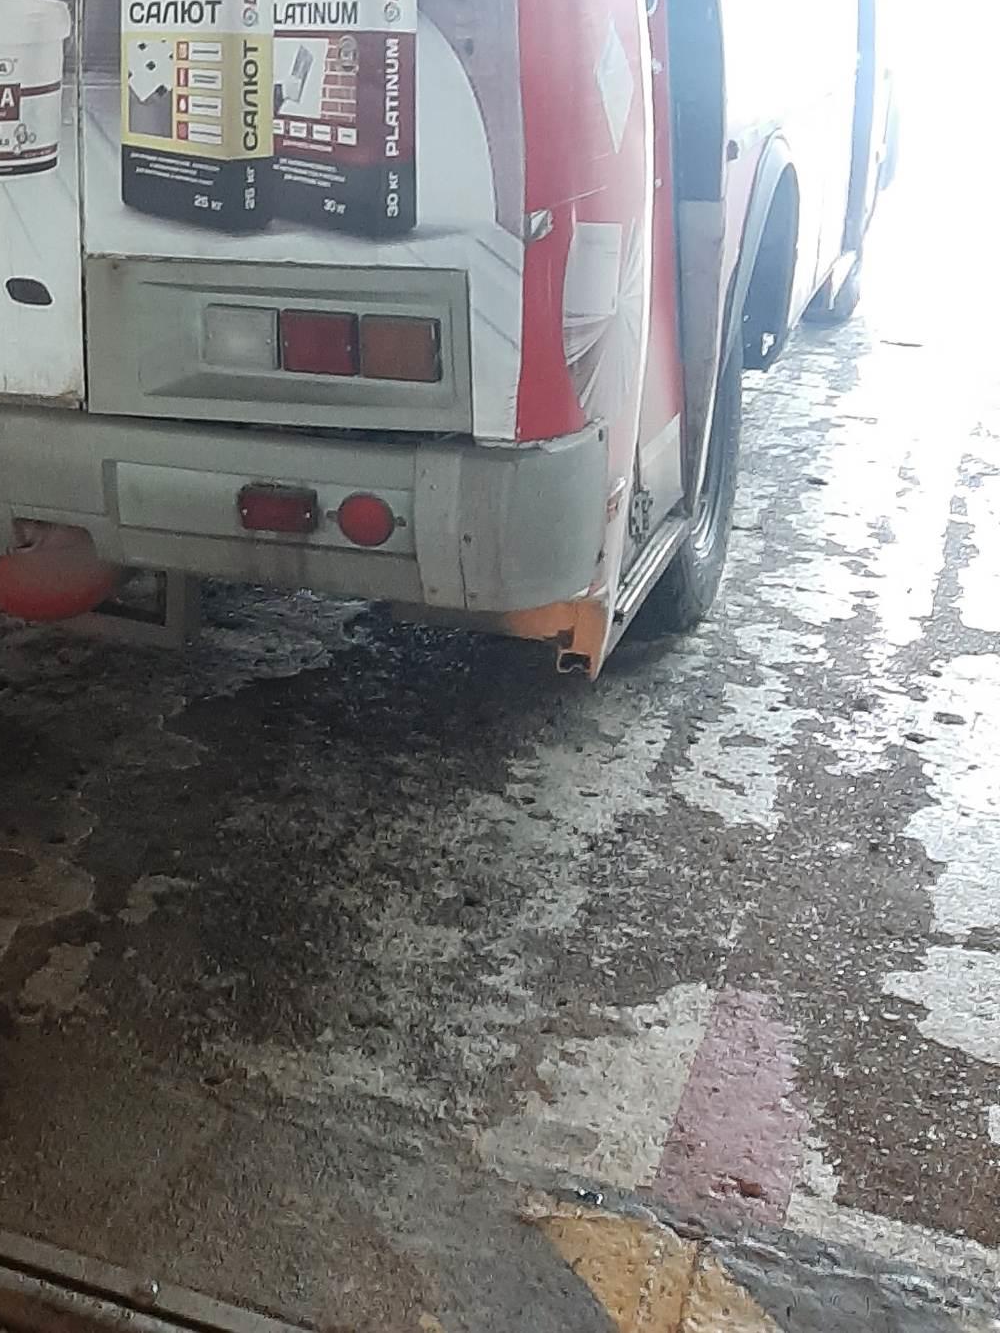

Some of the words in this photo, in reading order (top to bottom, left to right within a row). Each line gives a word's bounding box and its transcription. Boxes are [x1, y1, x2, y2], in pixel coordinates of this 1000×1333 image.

[129, 0, 223, 24] САЛЮТ
[243, 40, 258, 152] САЛЮТ
[385, 37, 400, 157] PLATINUM
